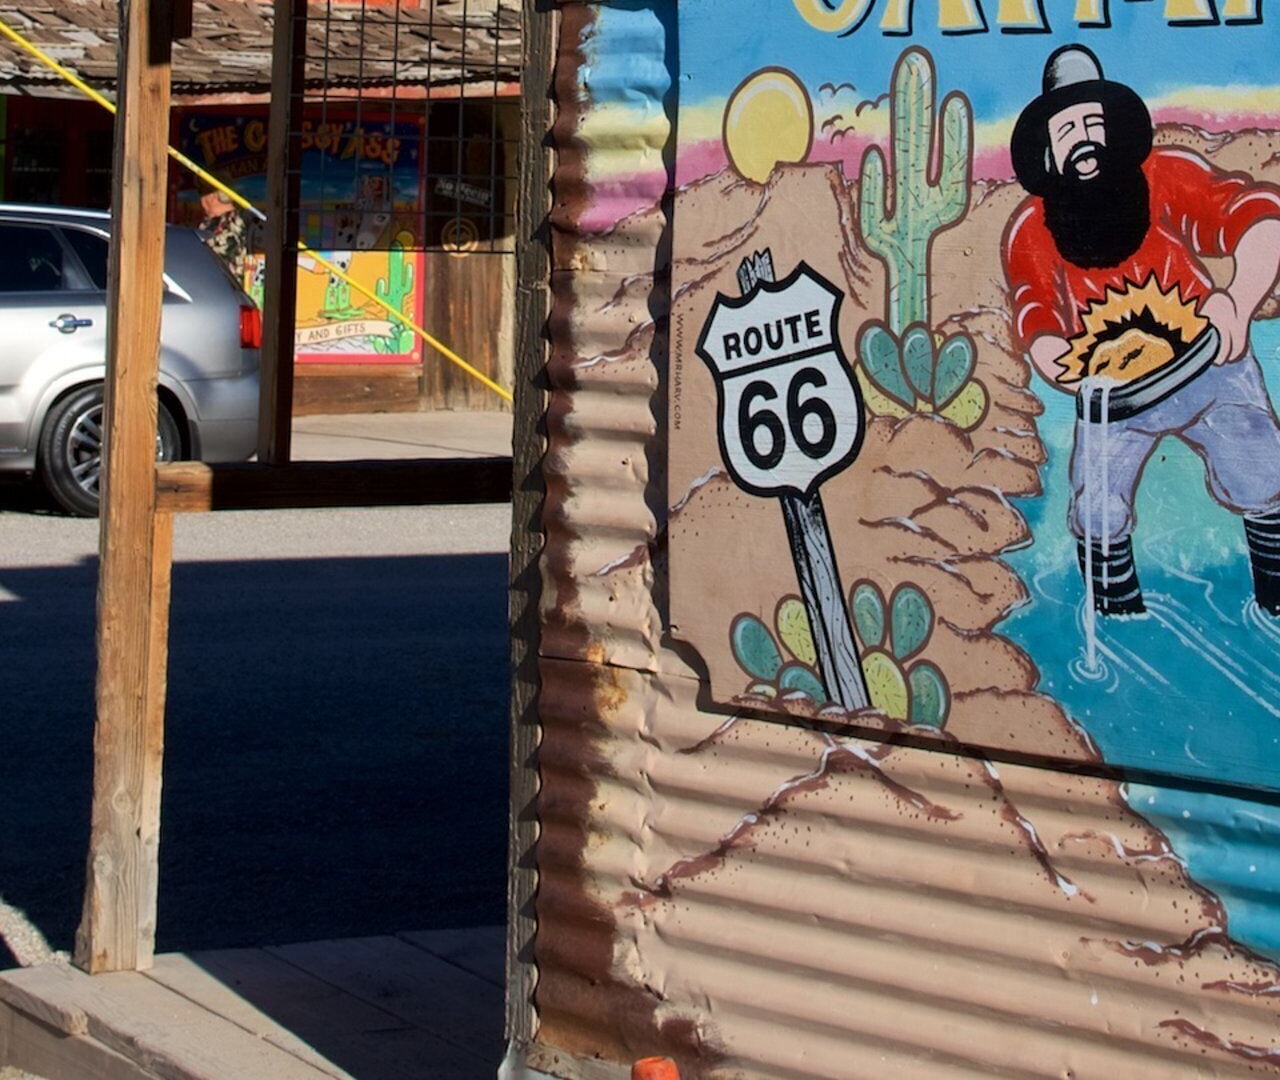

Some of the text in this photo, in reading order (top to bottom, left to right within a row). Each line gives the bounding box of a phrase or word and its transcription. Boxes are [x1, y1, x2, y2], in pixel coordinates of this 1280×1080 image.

[308, 328, 330, 341] AND
[335, 322, 366, 336] GIFTS
[722, 309, 824, 361] ROUTE
[737, 367, 838, 471] 66
